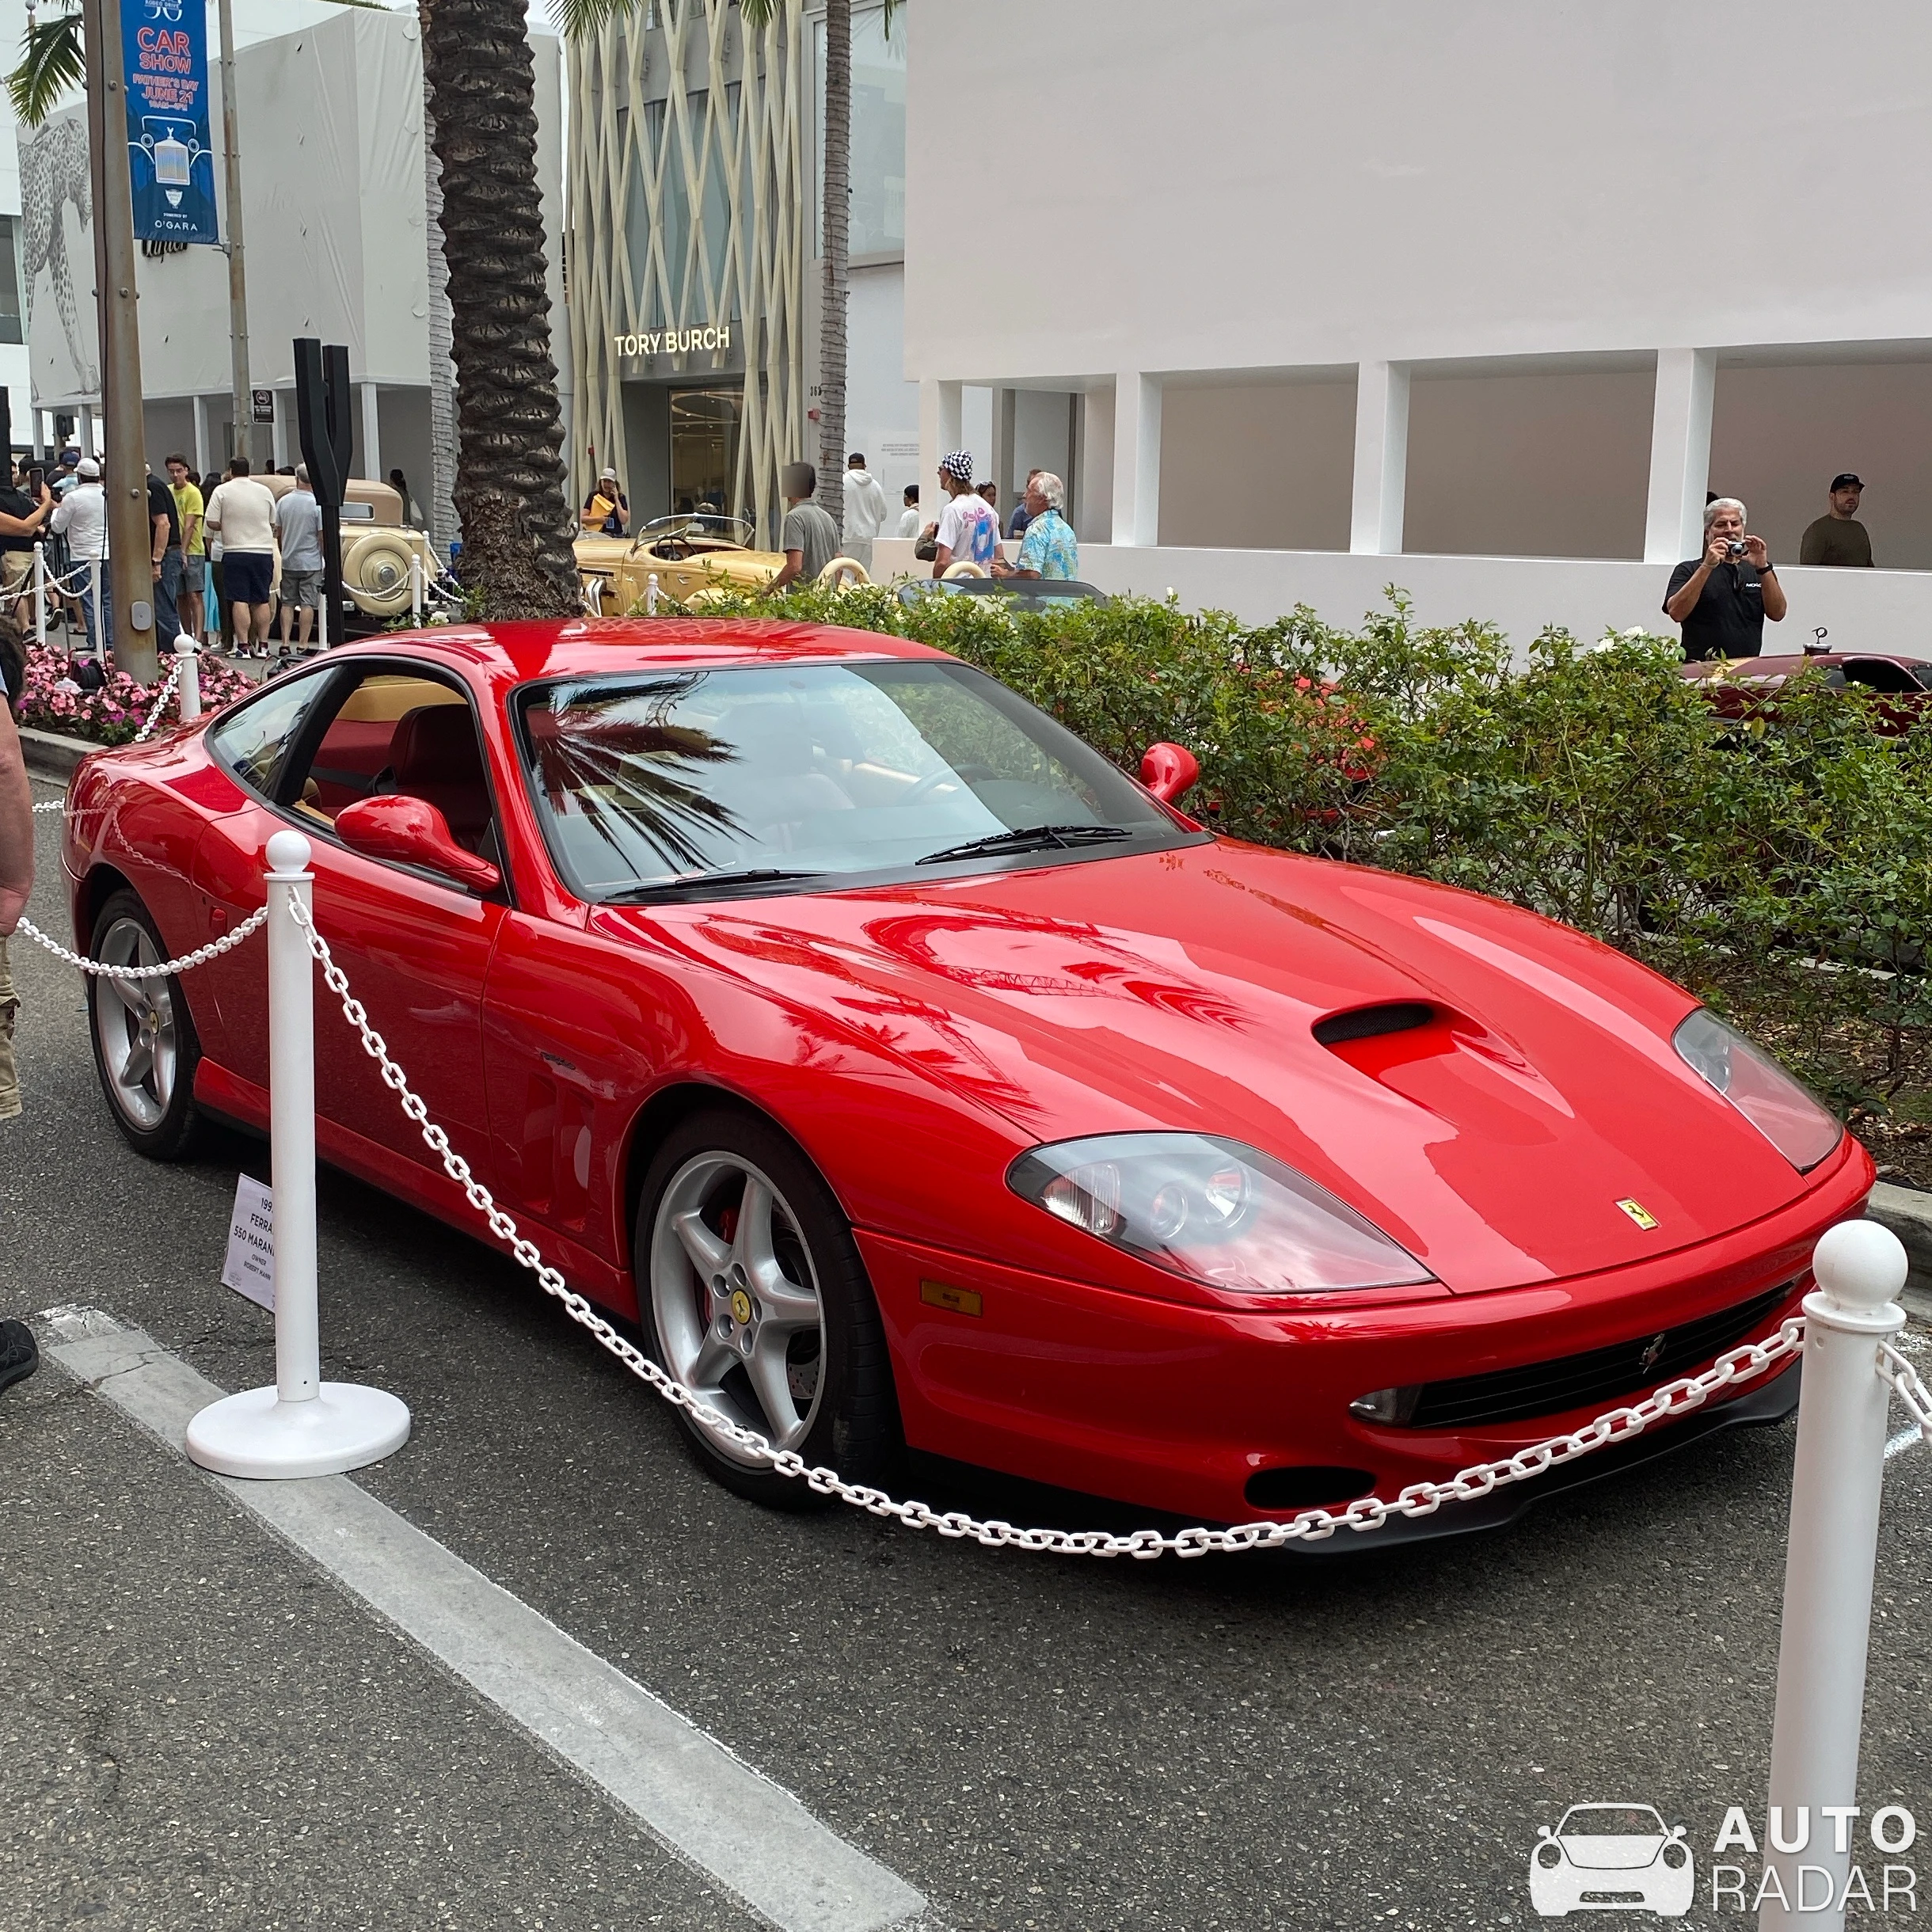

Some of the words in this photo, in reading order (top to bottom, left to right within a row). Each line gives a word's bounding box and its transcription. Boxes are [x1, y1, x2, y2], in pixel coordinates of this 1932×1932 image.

[138, 27, 191, 56] CAR
[139, 52, 191, 74] SHOW
[133, 73, 180, 88] FATHER'S
[181, 79, 199, 92] DAY
[141, 86, 178, 102] JUNE
[154, 220, 198, 231] O'GARA
[614, 333, 661, 356] TORY
[665, 325, 730, 353] BURCH
[261, 1197, 273, 1213] 199
[234, 1225, 247, 1241] 550
[251, 1253, 267, 1267] OWNER
